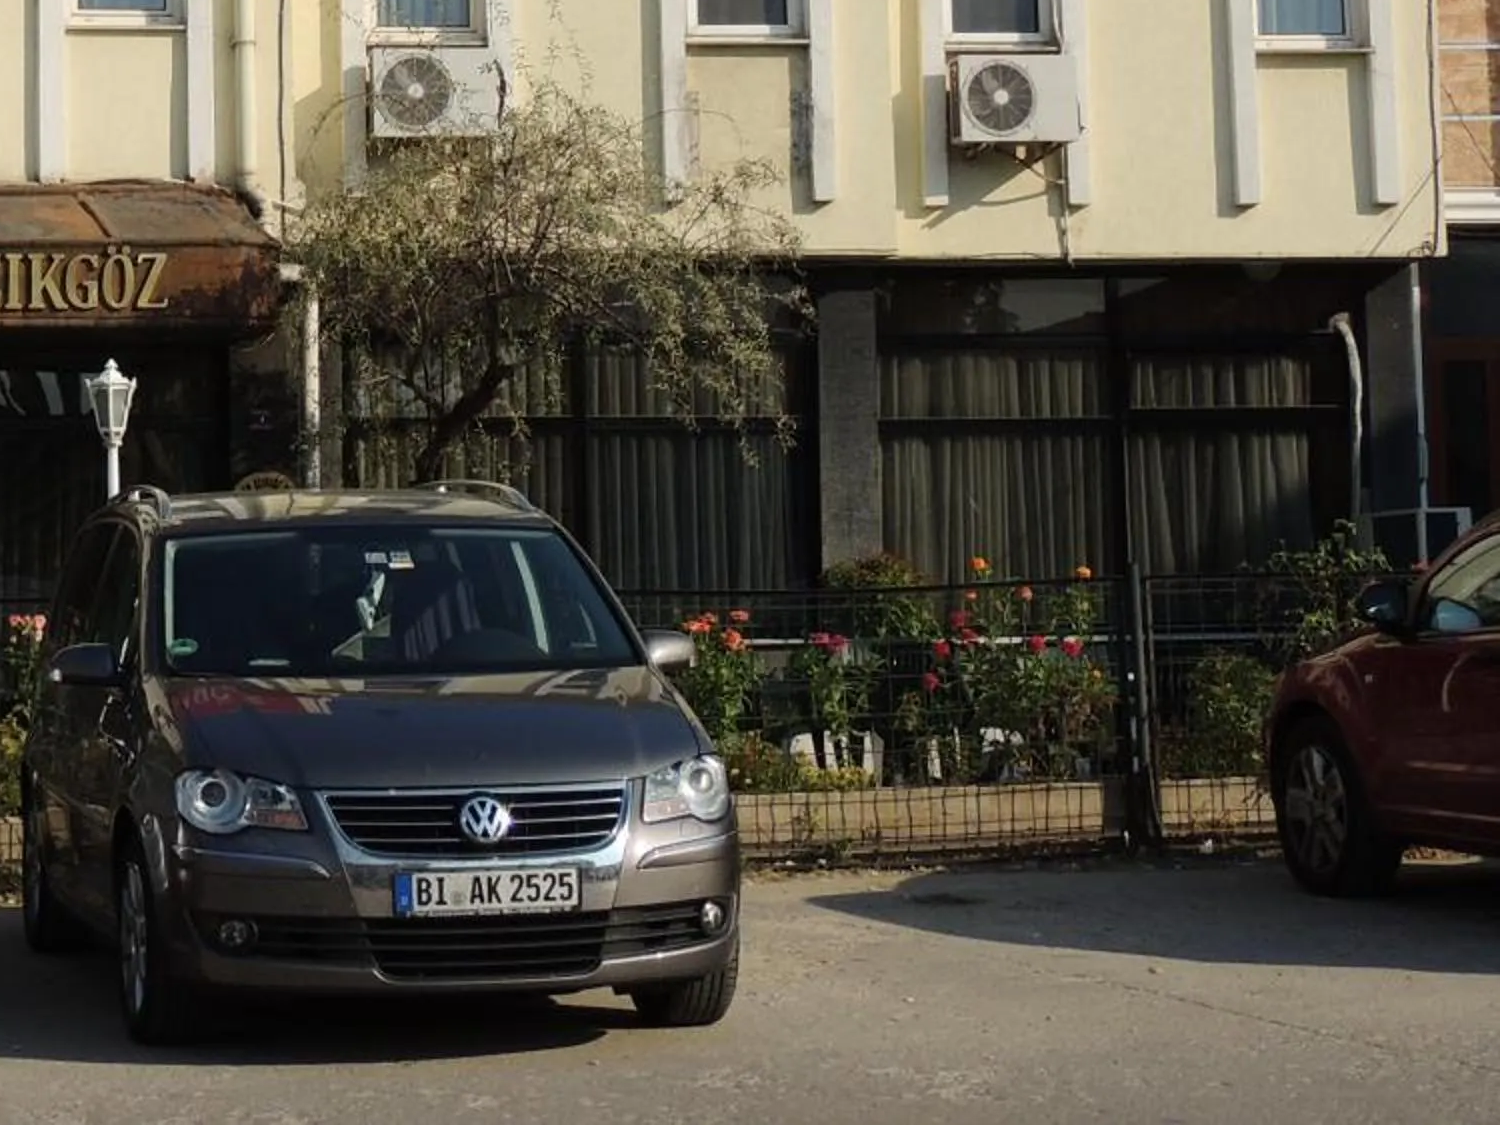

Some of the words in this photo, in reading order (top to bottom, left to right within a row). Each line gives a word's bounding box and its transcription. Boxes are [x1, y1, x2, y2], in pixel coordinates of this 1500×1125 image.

[416, 876, 448, 906] BI
[469, 875, 503, 904] AK
[509, 872, 574, 903] 2525
